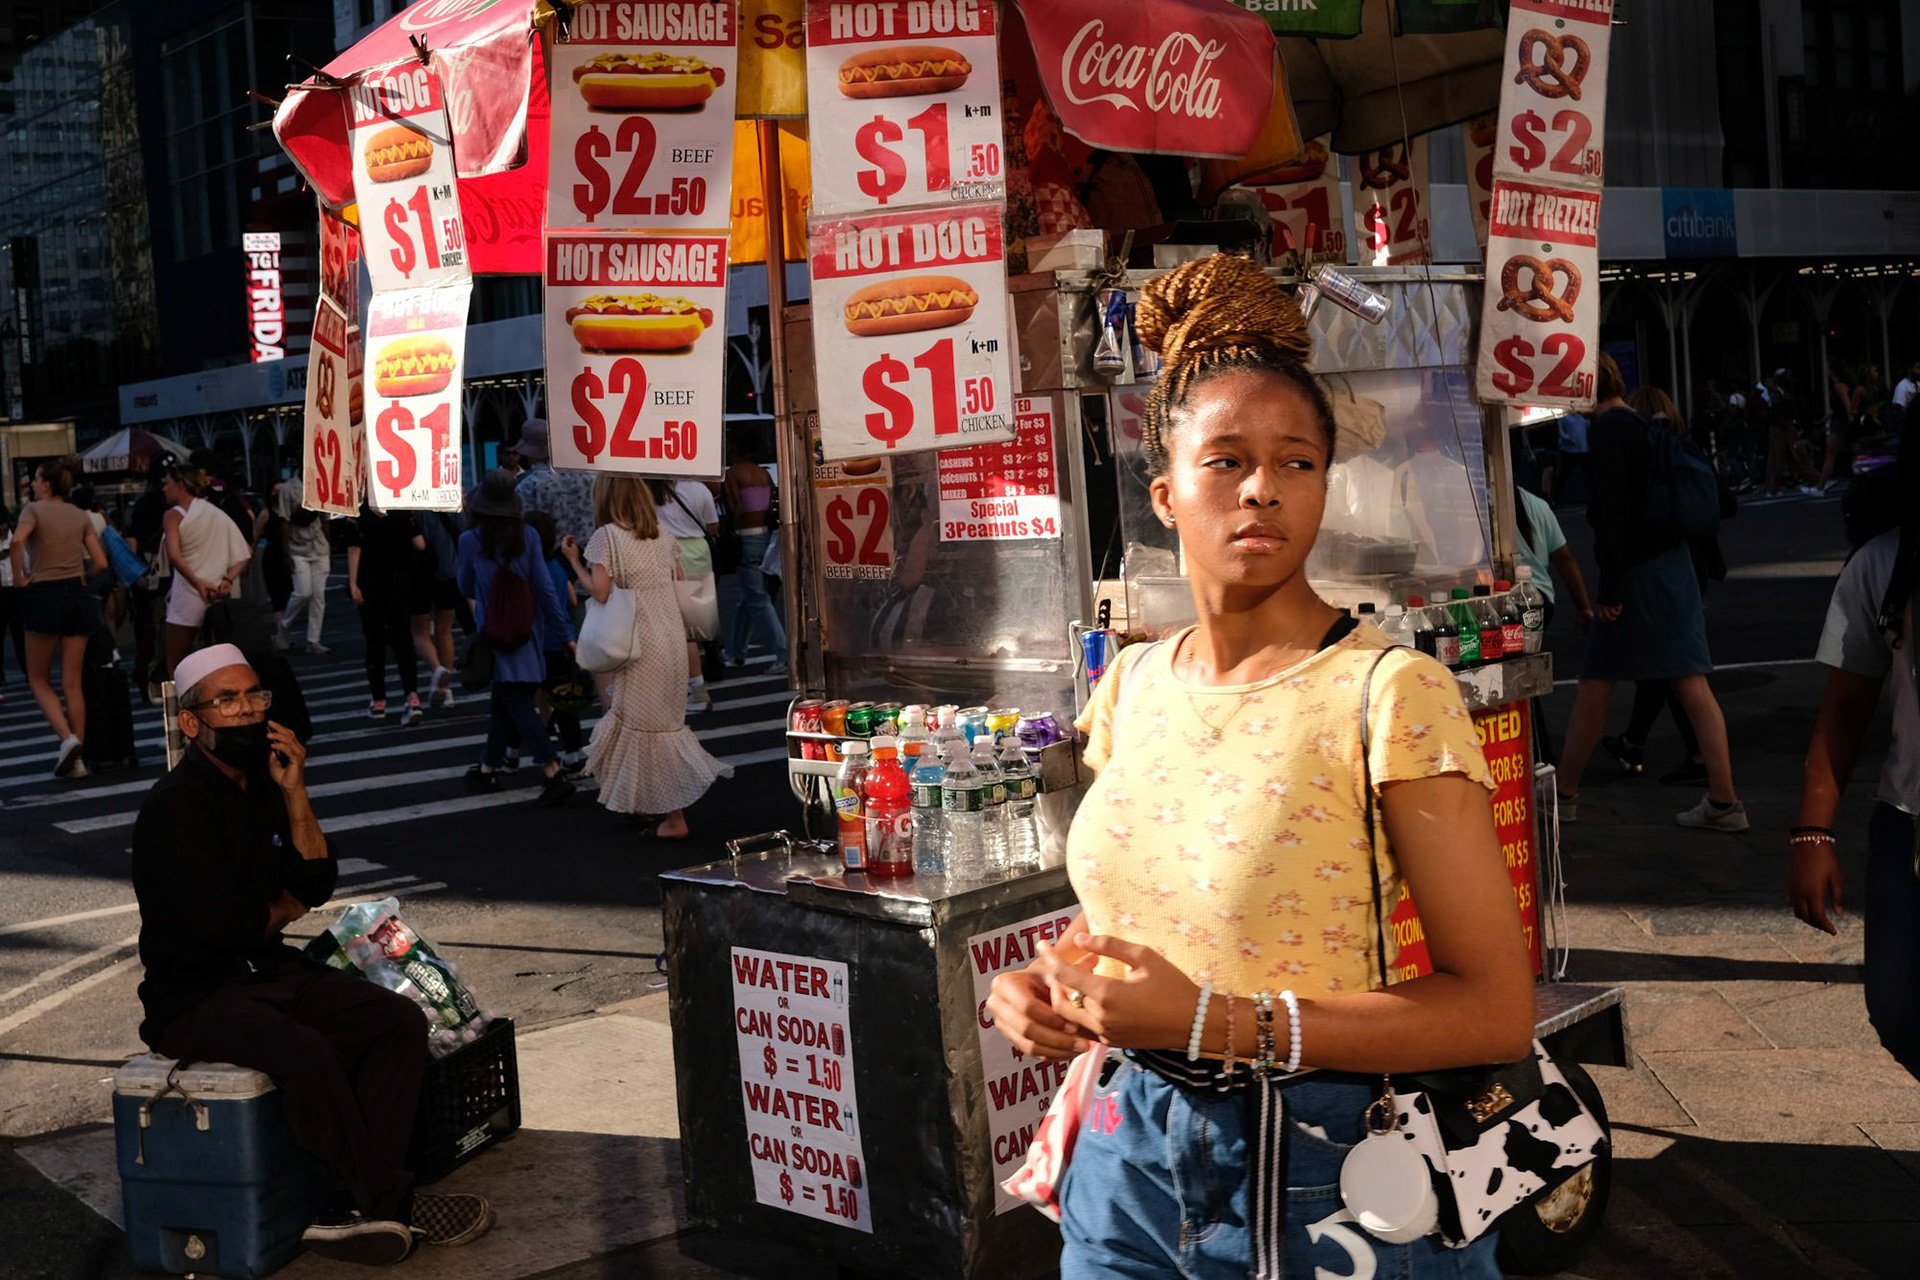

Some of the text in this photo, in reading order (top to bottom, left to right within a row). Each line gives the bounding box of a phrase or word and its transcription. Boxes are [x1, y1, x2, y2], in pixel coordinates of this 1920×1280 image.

[1245, 0, 1318, 12] Bank
[617, 2, 729, 41] SAUSAGE
[831, 0, 981, 40] HOT DOG
[349, 79, 384, 123] HOT
[384, 68, 431, 114] DOG
[964, 104, 992, 118] k+m
[671, 147, 714, 164] BEEF
[433, 184, 451, 200] K+M
[950, 183, 997, 201] CHICKEN
[1497, 196, 1597, 236] HOT PRETZEL
[1667, 210, 1735, 239] citibank
[834, 216, 988, 272] HOT DOG
[249, 252, 279, 269] TGI
[556, 240, 719, 282] HOT SAUSAGE
[250, 269, 285, 363] FRIDA
[971, 338, 999, 354] k+m
[653, 389, 695, 406] BEEF
[961, 414, 1006, 433] CHICKEN
[1033, 433, 1046, 446] $5
[814, 466, 839, 480] BEEF
[940, 457, 975, 470] CASHEWS
[1002, 454, 1014, 466] $3
[1037, 452, 1049, 463] $5
[1003, 469, 1016, 481] $3
[1037, 467, 1049, 479] $5
[411, 489, 431, 504] K+M
[941, 488, 968, 501] MIXED
[1004, 484, 1017, 497] $4
[1038, 483, 1050, 495] $7
[970, 499, 1019, 520] Special
[826, 487, 890, 566] $2
[944, 516, 1056, 540] 3Peanuts $4
[827, 565, 885, 579] BEEF BEEF
[1490, 753, 1525, 785] FOR $3
[1493, 796, 1526, 828] FOR $5
[1516, 839, 1529, 867] $5
[1519, 882, 1531, 911] $5
[733, 954, 831, 999] WATER
[777, 996, 790, 1009] OR
[736, 1006, 830, 1050] CAN SODA
[763, 1042, 778, 1080] $
[806, 1053, 842, 1092] 1.50
[988, 1058, 1073, 1111] WATE
[744, 1081, 844, 1132] WATER
[1038, 1096, 1050, 1112] OR
[790, 1125, 803, 1139] OR
[994, 1123, 1033, 1165] CAN
[750, 1132, 847, 1181] CAN SODA
[779, 1168, 794, 1206] $
[822, 1183, 859, 1222] 1.50
